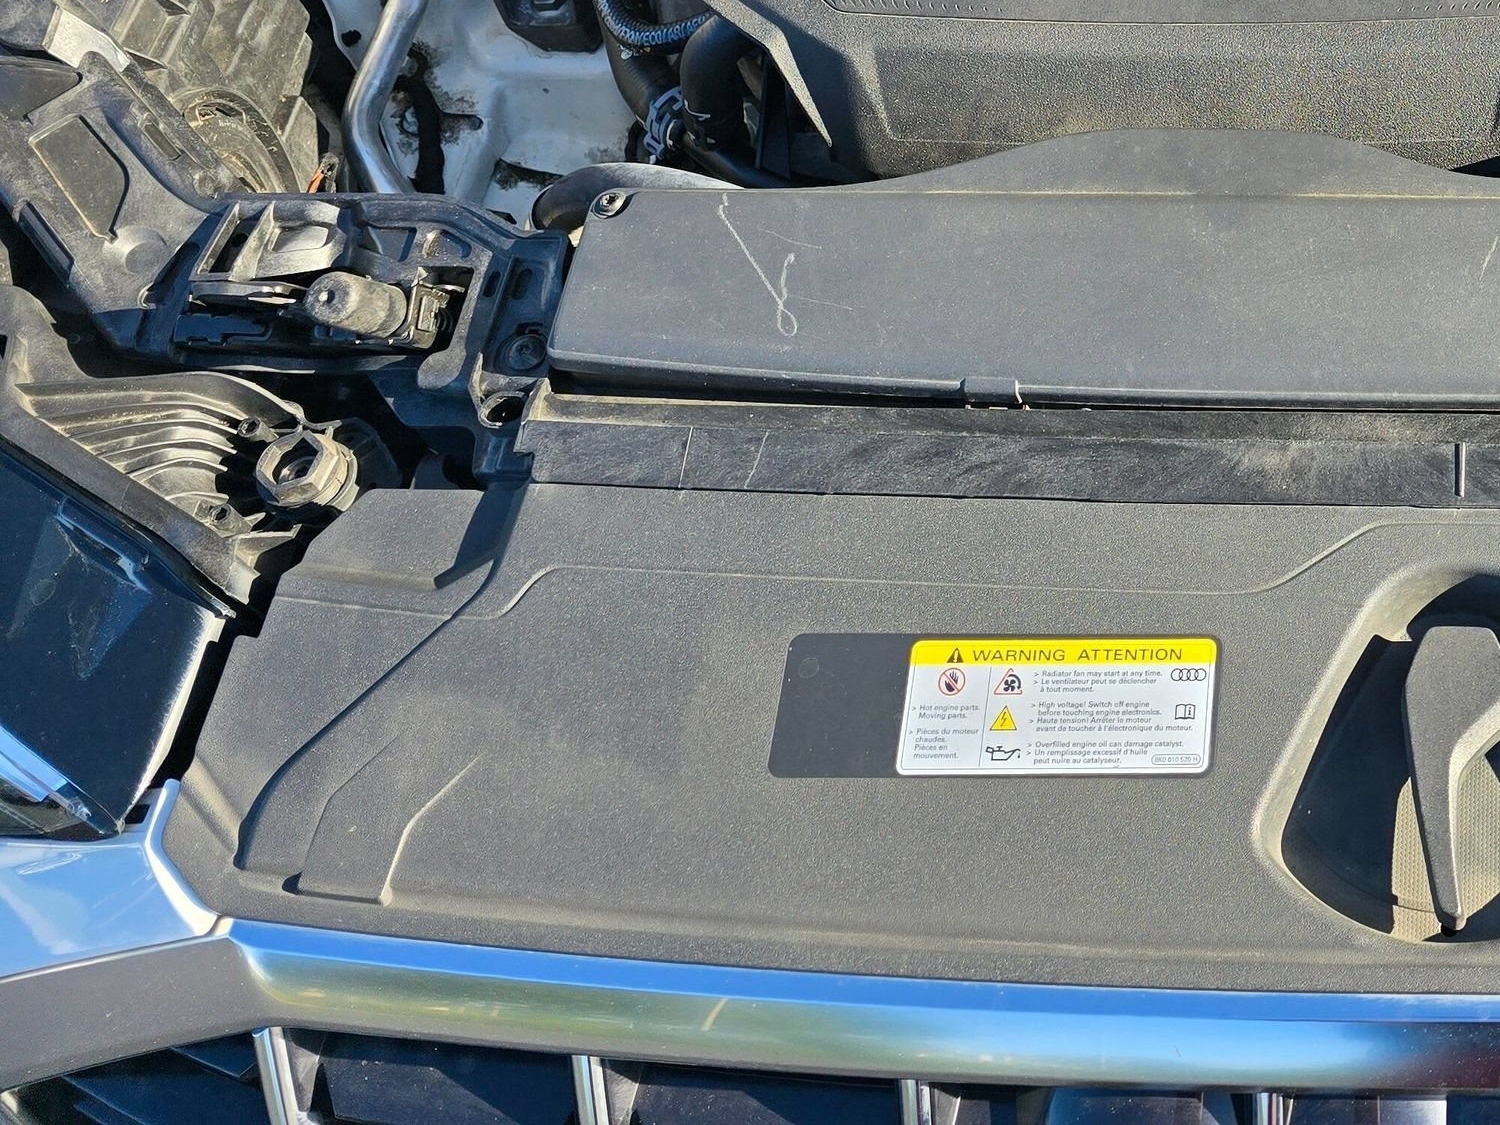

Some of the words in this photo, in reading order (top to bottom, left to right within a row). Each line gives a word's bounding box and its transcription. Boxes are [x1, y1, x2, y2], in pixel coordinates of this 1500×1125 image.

[972, 649, 1065, 661] WARNING
[1077, 648, 1183, 661] ATTENTION
[1091, 678, 1107, 686] peut
[1039, 701, 1055, 709] High
[1057, 701, 1086, 709] voltage!
[919, 712, 946, 720] Moving
[1062, 709, 1094, 717] touching
[1096, 709, 1120, 717] engine
[1072, 741, 1096, 749] engine
[1124, 741, 1152, 749] damage
[1155, 740, 1184, 749] catalyst.
[1047, 749, 1091, 757] remplissage
[1034, 757, 1050, 765] peut
[1083, 757, 1122, 765] catalyseur.
